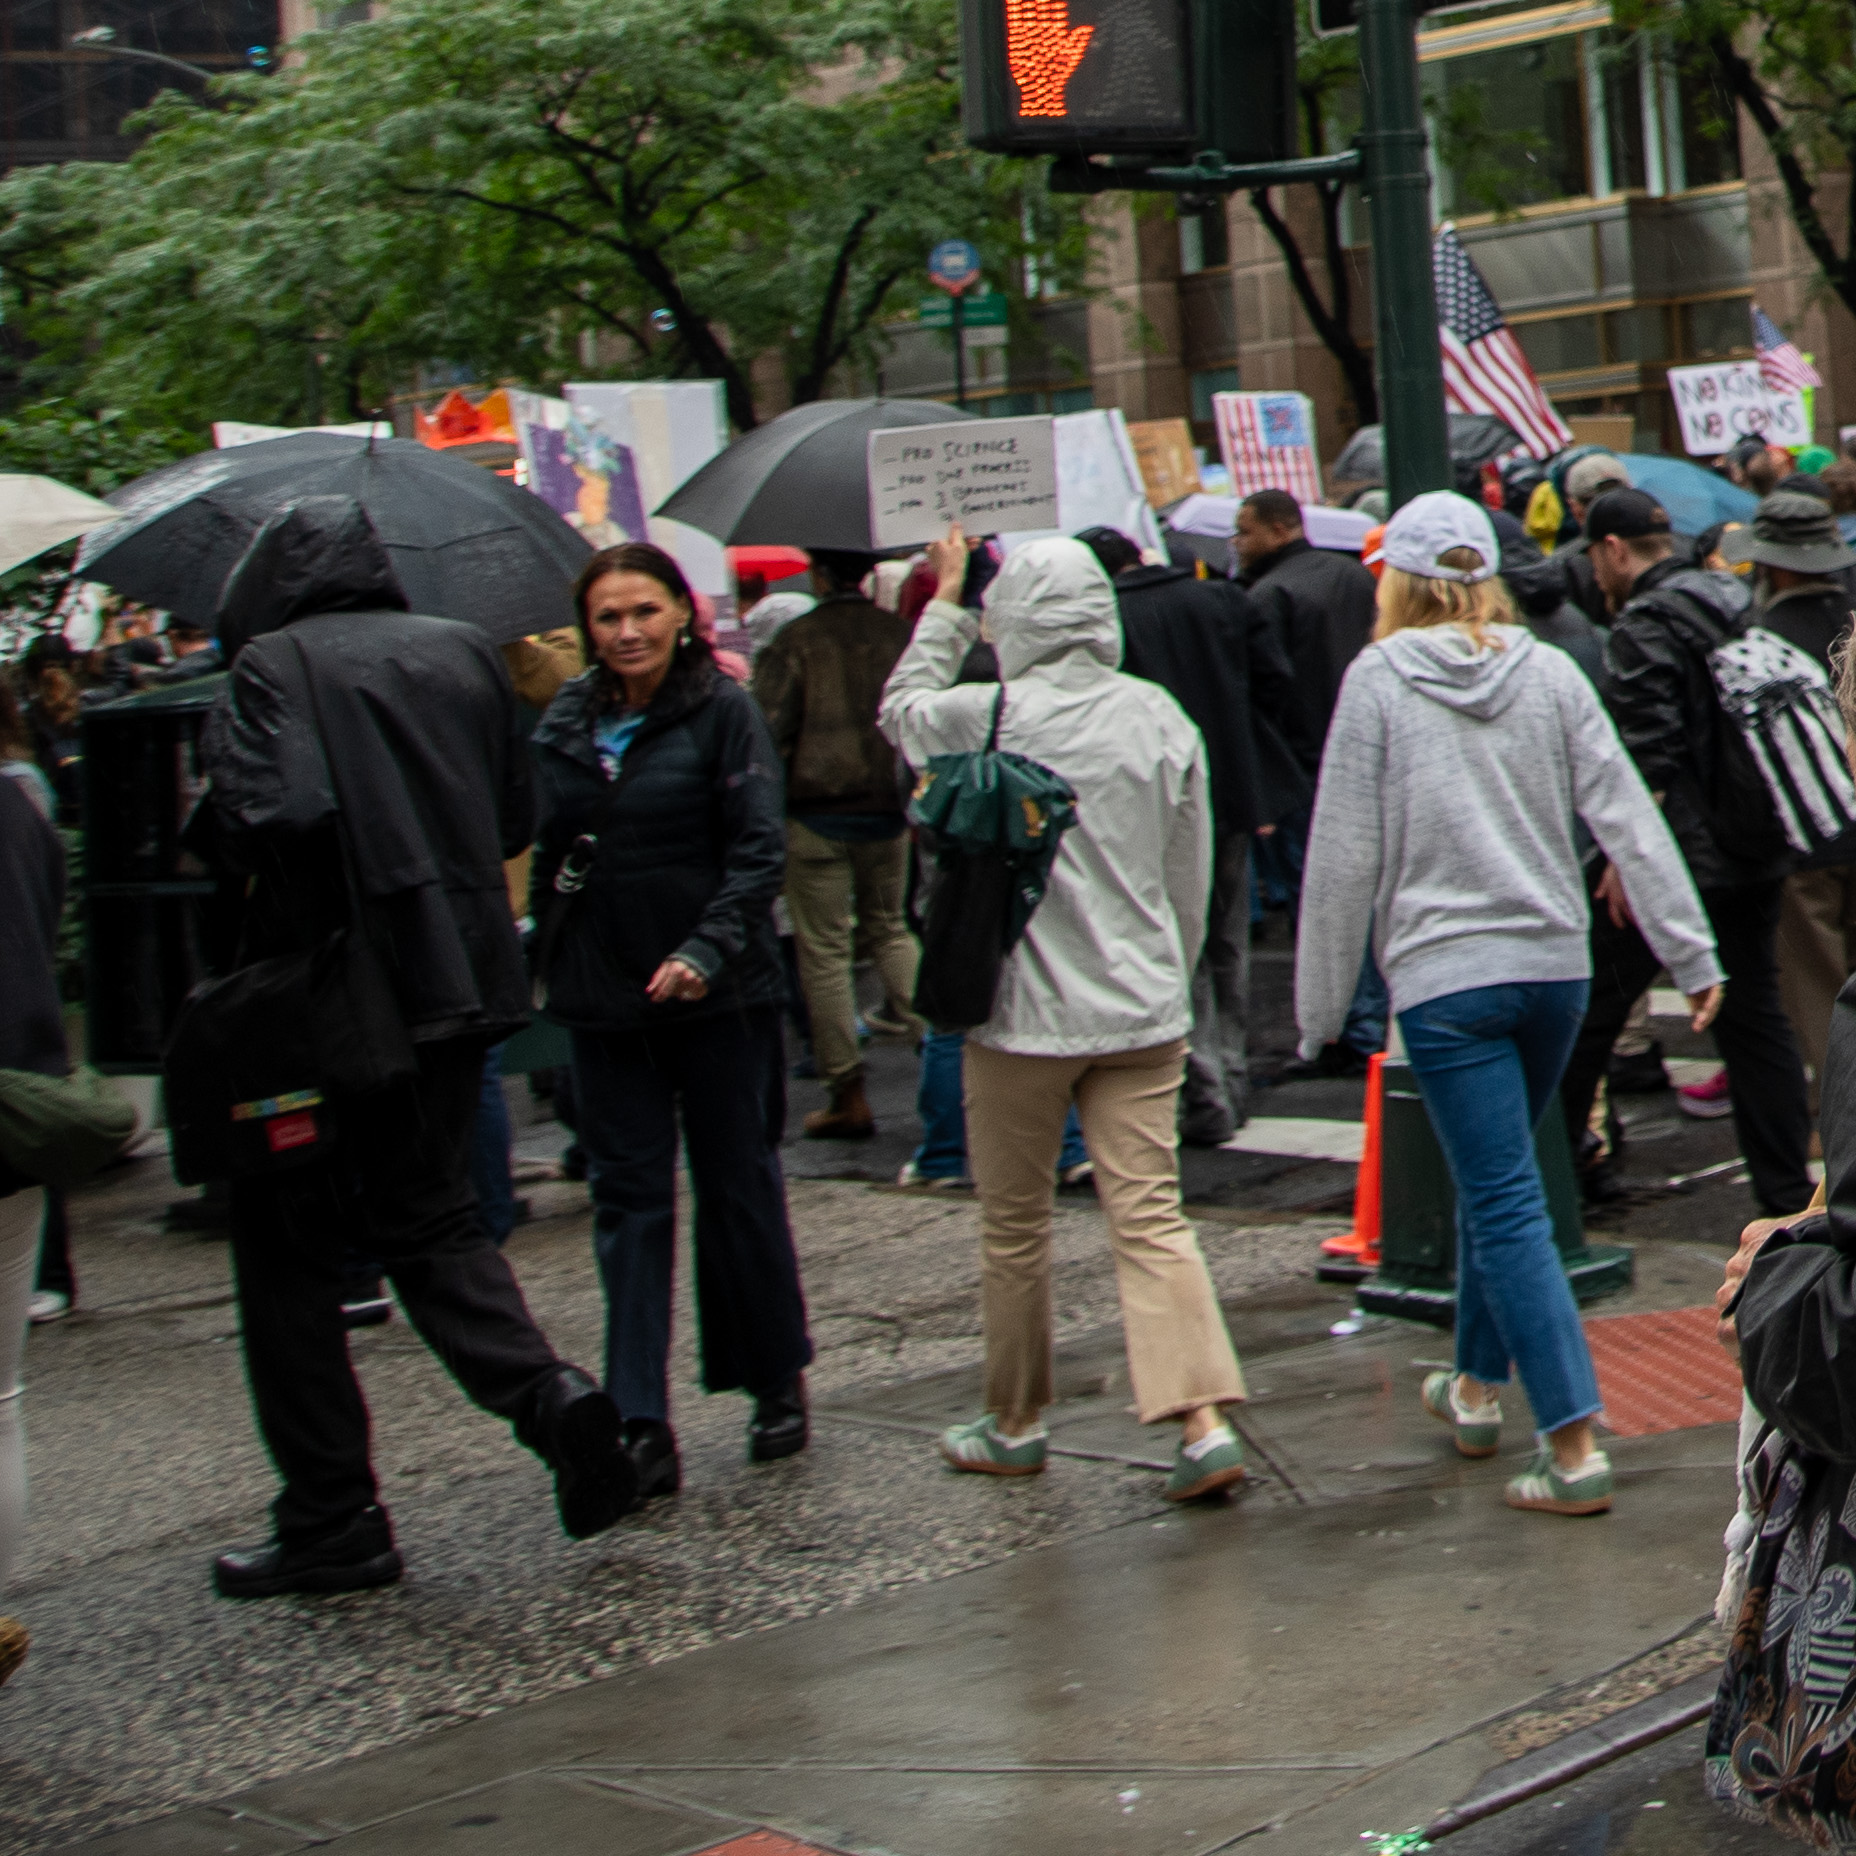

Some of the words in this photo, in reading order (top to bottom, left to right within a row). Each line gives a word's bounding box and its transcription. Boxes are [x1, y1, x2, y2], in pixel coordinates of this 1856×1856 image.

[1677, 375, 1718, 407] NO
[1689, 411, 1725, 445] NO
[943, 437, 1018, 462] SCIENCE
